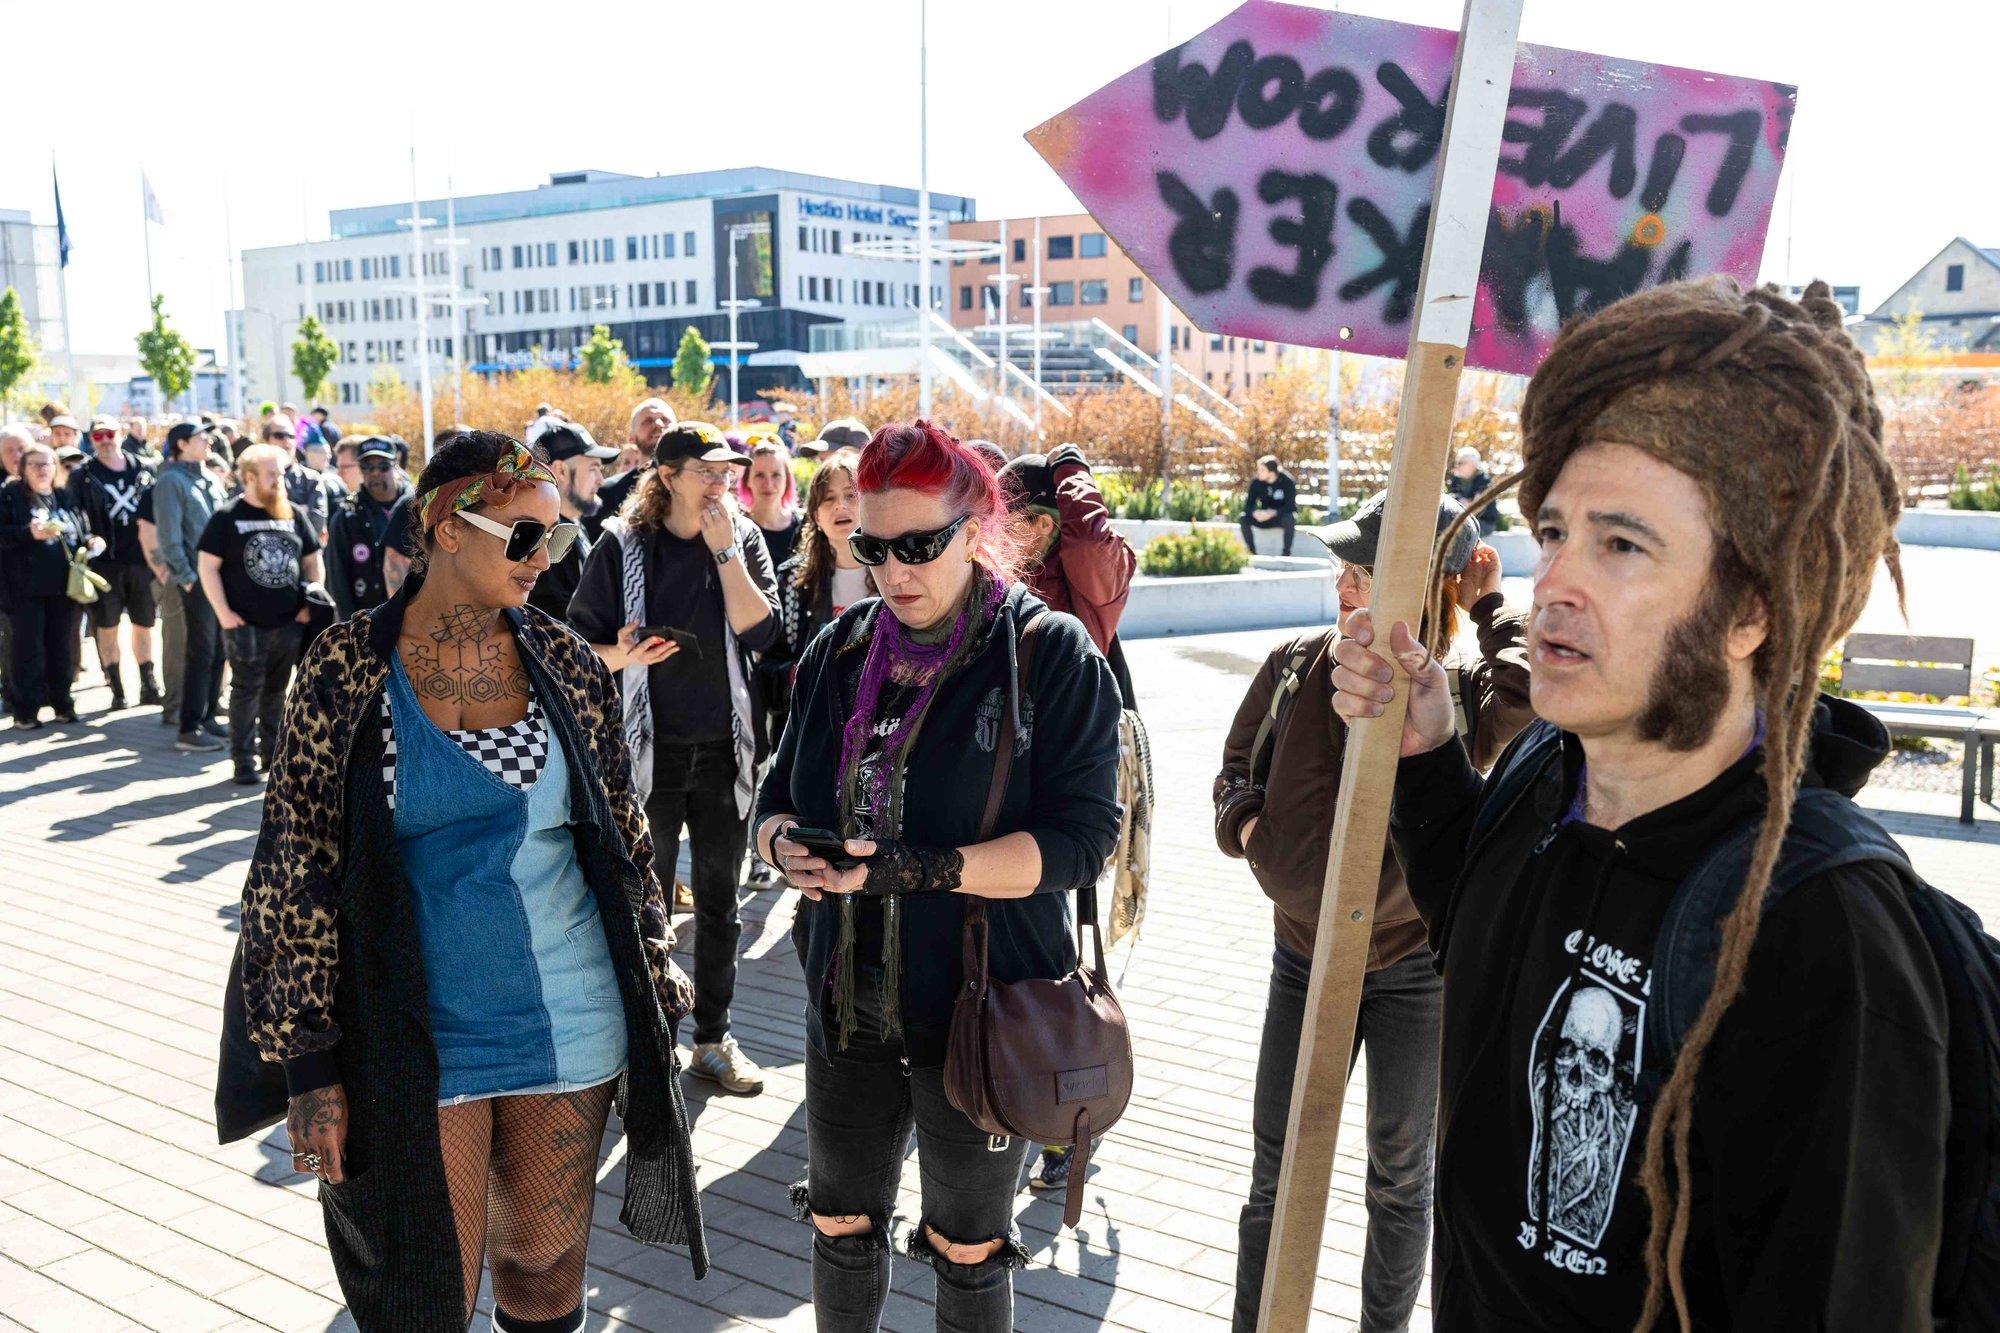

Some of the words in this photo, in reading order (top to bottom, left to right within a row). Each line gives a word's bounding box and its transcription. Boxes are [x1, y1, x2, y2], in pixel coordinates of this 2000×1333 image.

[1151, 39, 1450, 174] ROOM
[1497, 88, 1763, 217] LIVE
[847, 204, 883, 224] Hotel
[1156, 168, 1692, 338] ANKER
